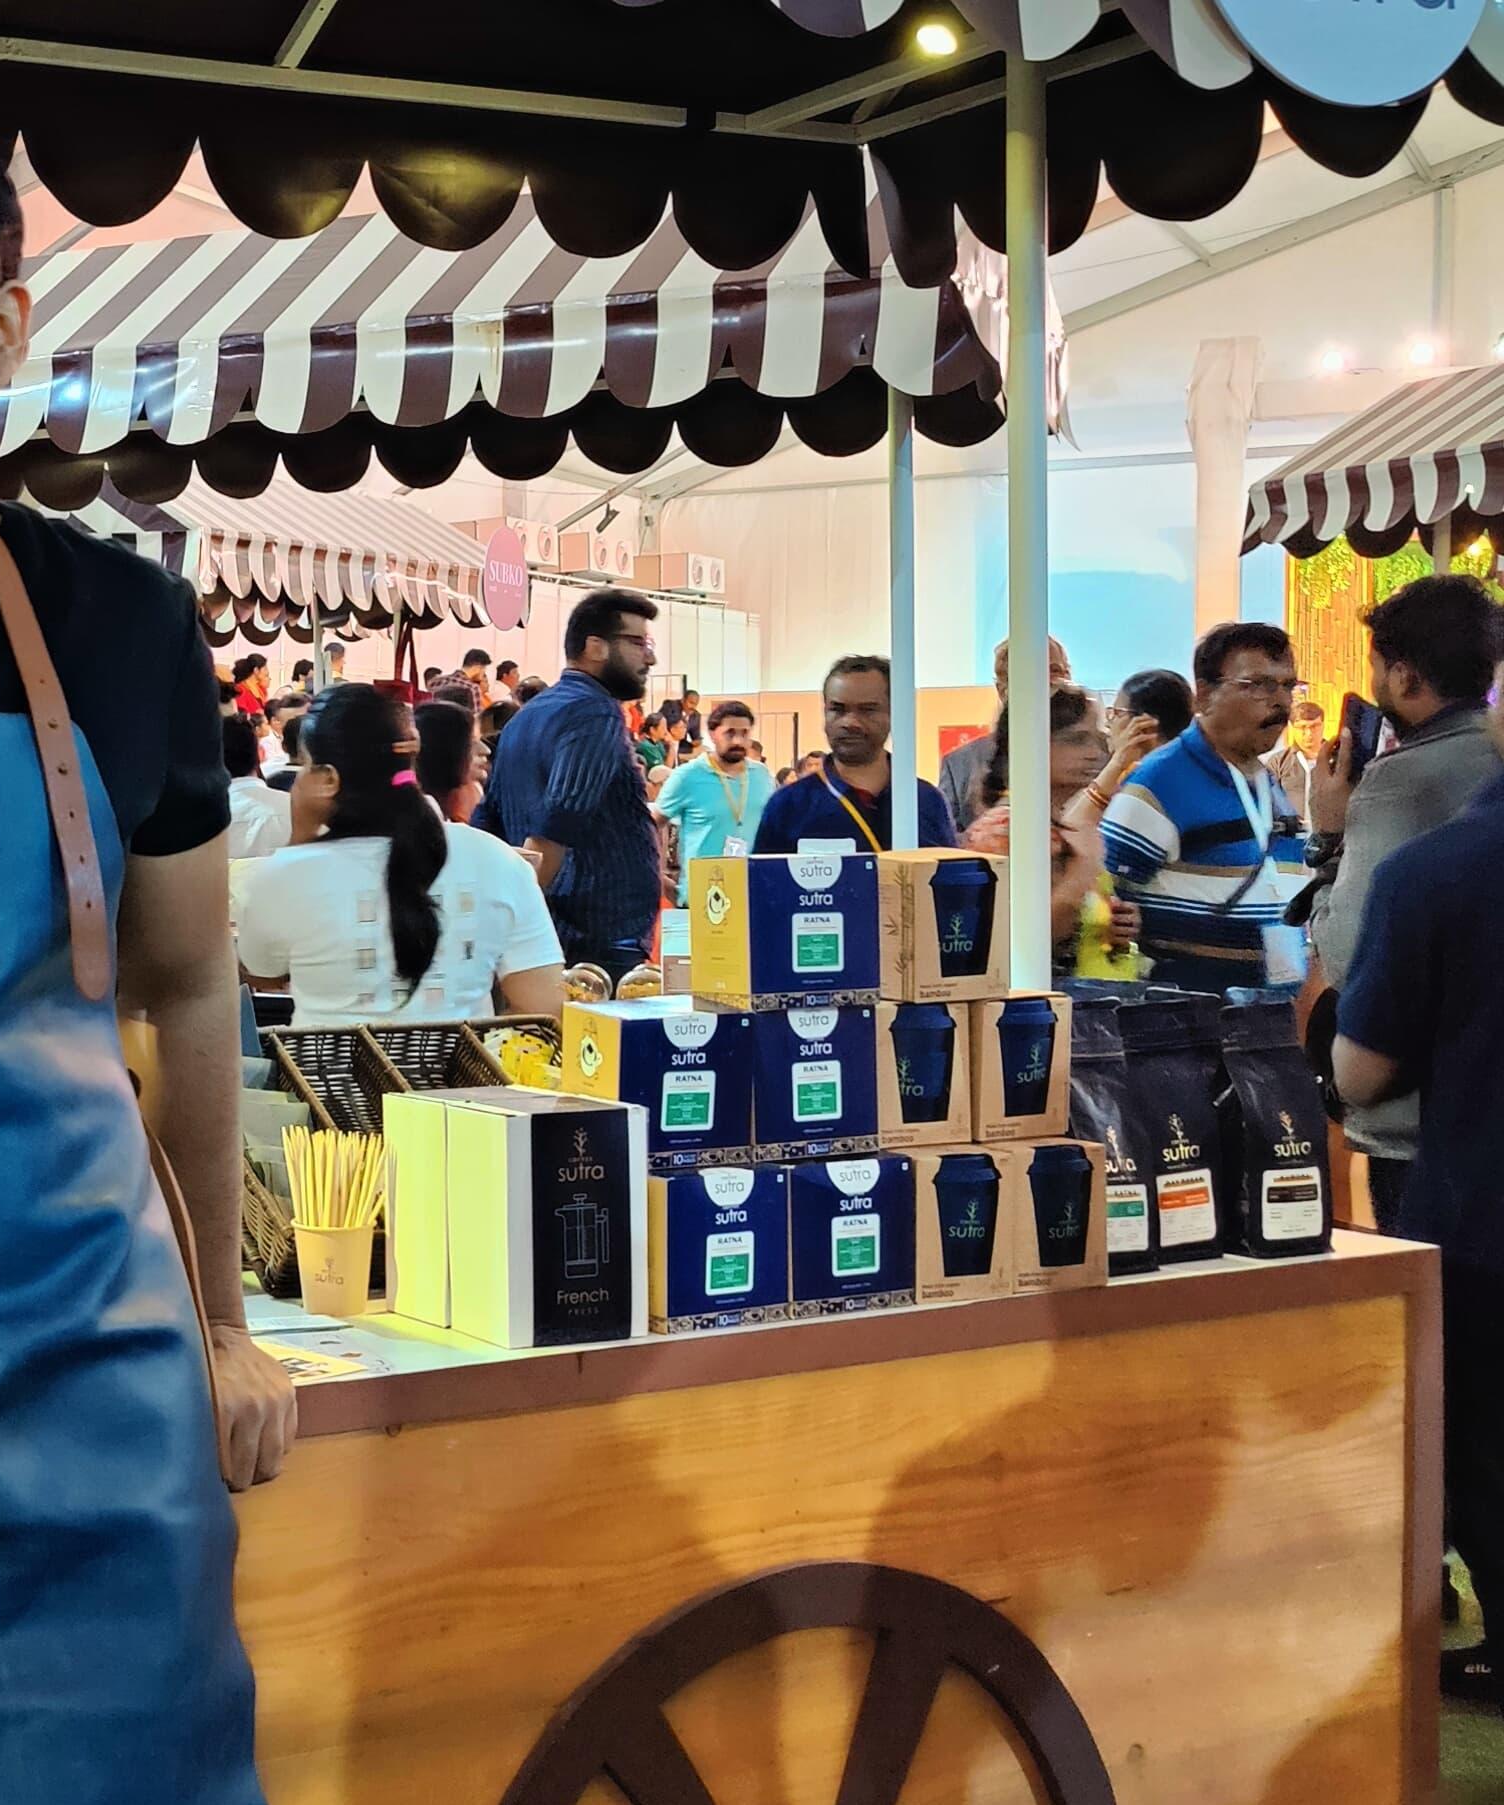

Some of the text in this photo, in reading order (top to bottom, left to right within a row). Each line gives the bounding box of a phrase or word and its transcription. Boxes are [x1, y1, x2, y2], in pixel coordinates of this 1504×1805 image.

[489, 560, 523, 587] SUBKO
[800, 865, 832, 877] sutra
[799, 892, 833, 906] sutra
[940, 939, 973, 953] utra
[799, 1014, 829, 1027] sutra
[674, 1023, 707, 1035] sutra
[799, 1041, 833, 1056] sutra
[671, 1050, 707, 1066] sutra
[1162, 1143, 1201, 1162] sutra
[1274, 1141, 1312, 1157] sutra
[558, 1163, 605, 1182] sutra
[840, 1170, 872, 1182] sutra
[715, 1181, 745, 1194] sutra
[839, 1195, 873, 1211] sutra
[715, 1208, 748, 1225] sutra
[556, 1287, 610, 1305] French
